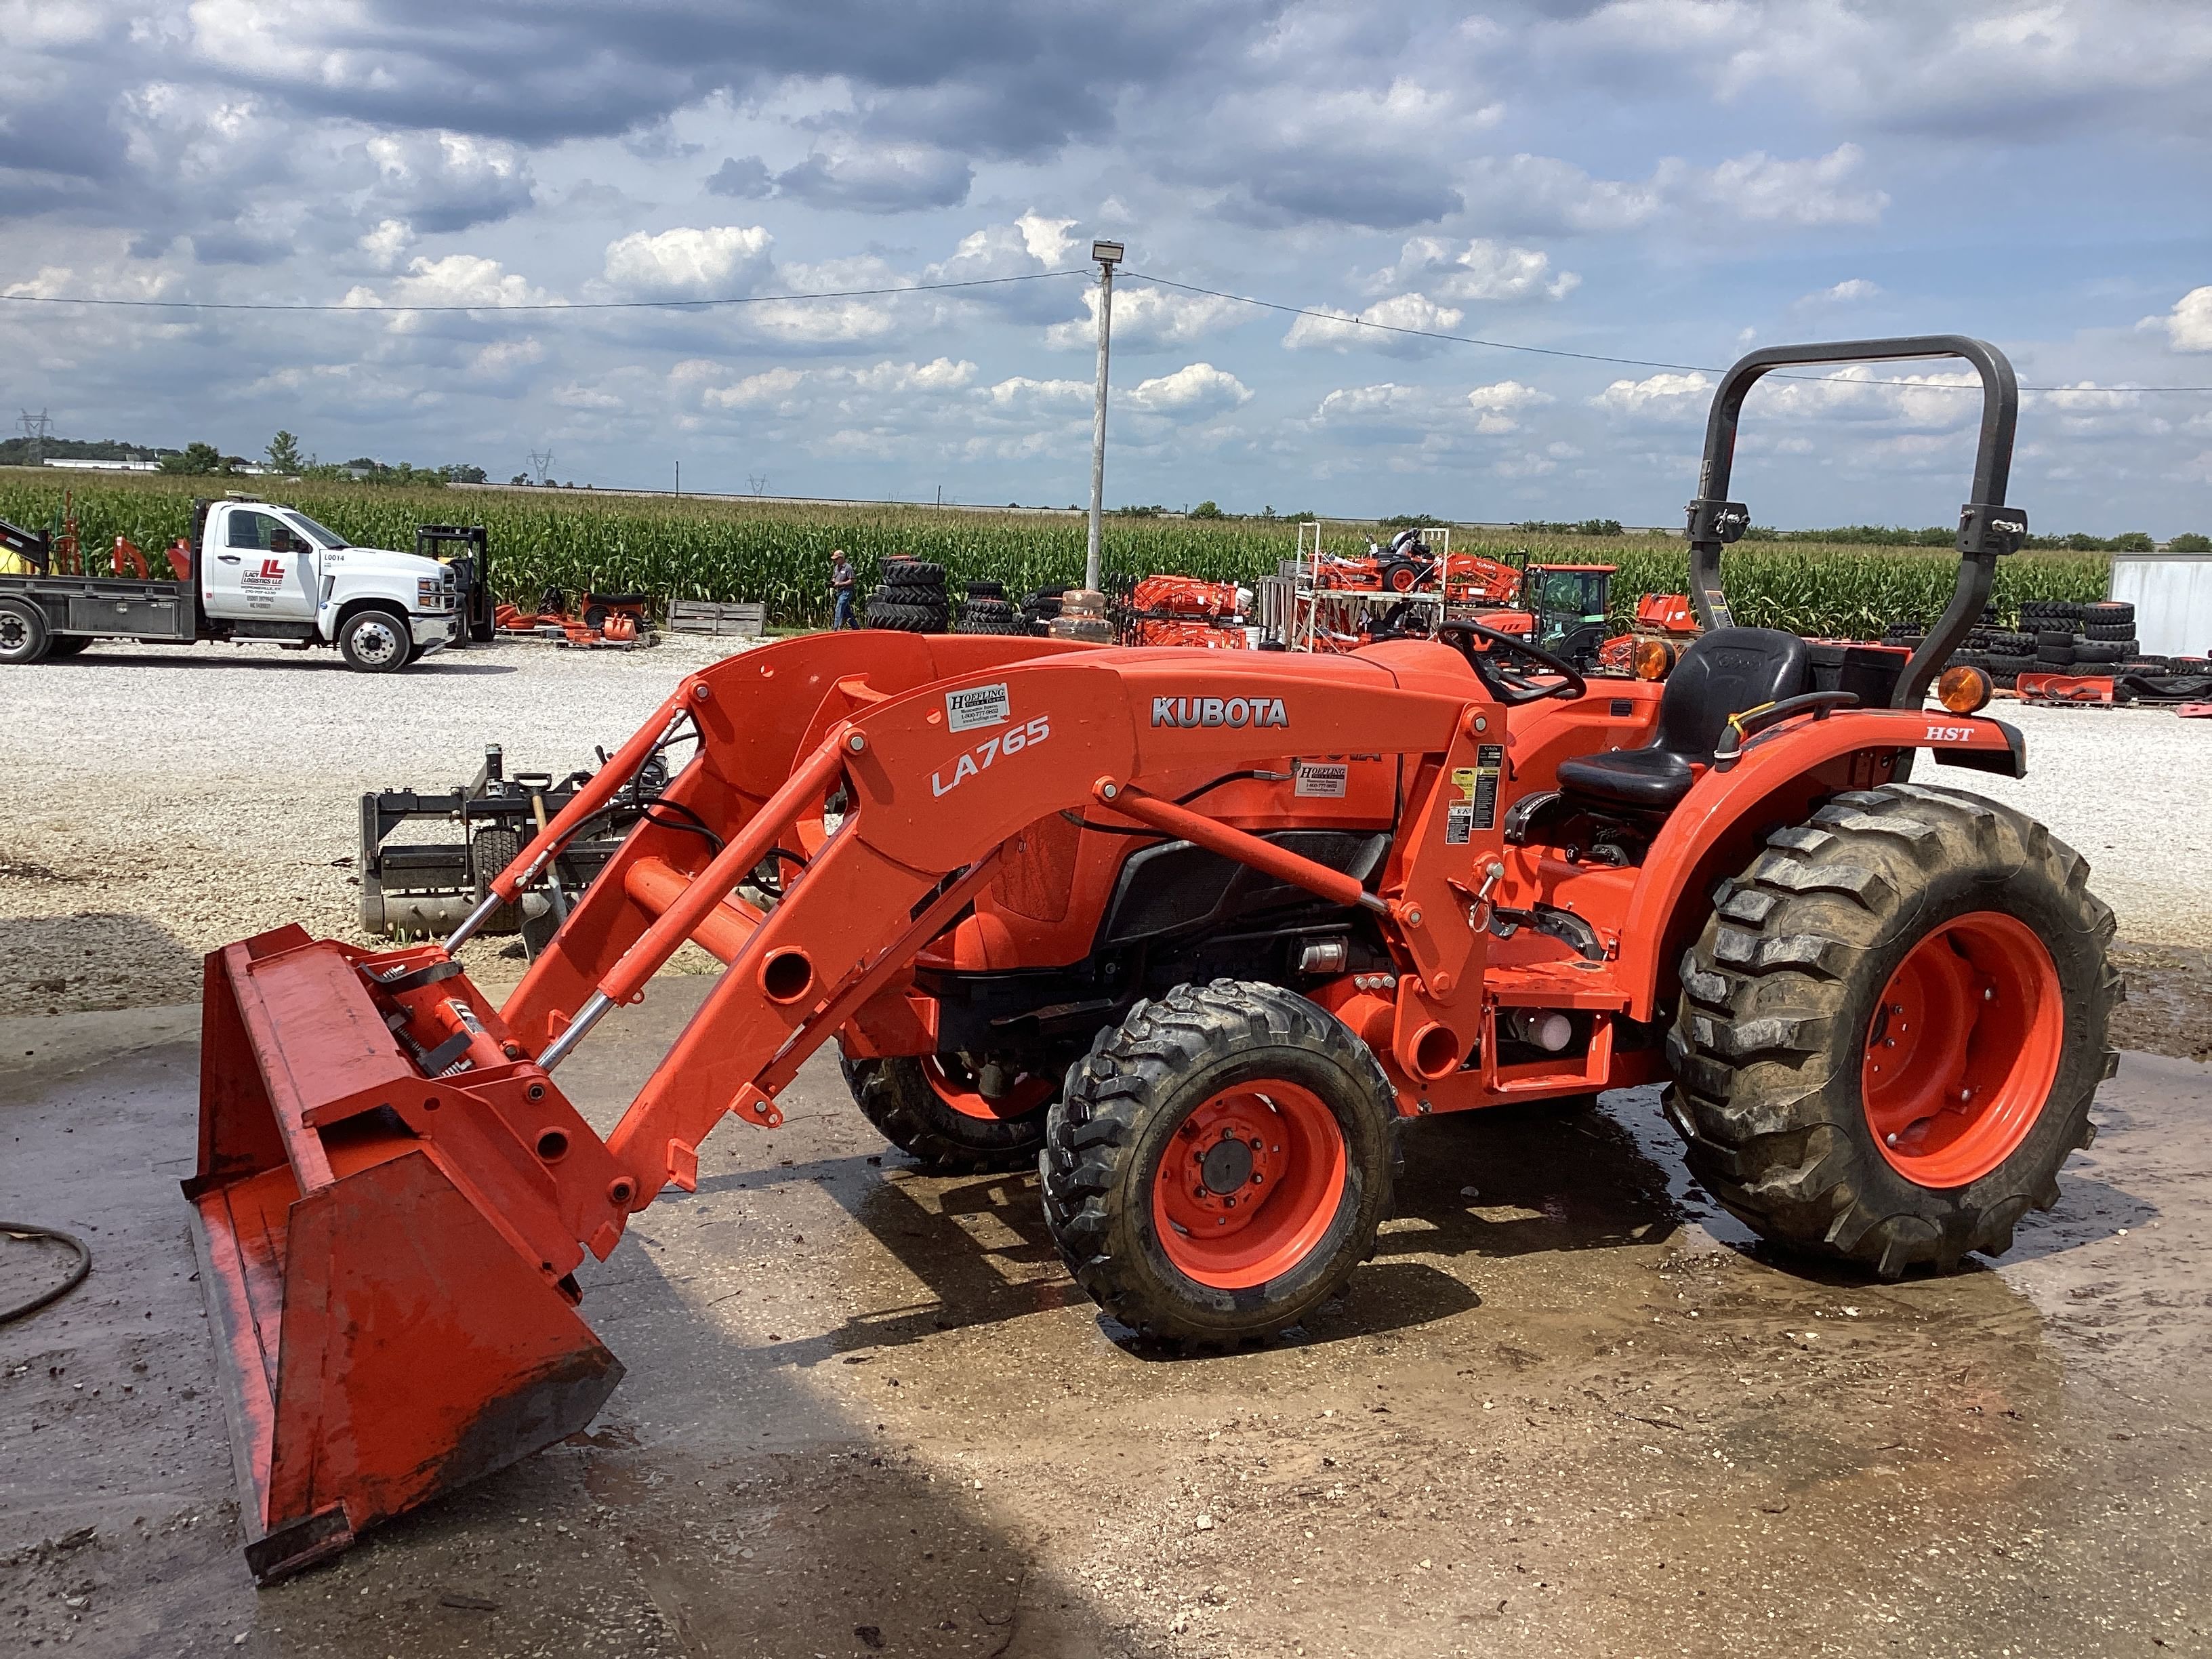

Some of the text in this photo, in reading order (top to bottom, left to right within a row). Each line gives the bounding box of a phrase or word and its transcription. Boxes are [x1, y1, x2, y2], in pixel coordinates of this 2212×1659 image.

[951, 689, 1004, 710] HOEFLING
[1151, 697, 1290, 729] KUBOTA
[1923, 726, 1975, 742] HST
[932, 716, 1050, 797] LA765
